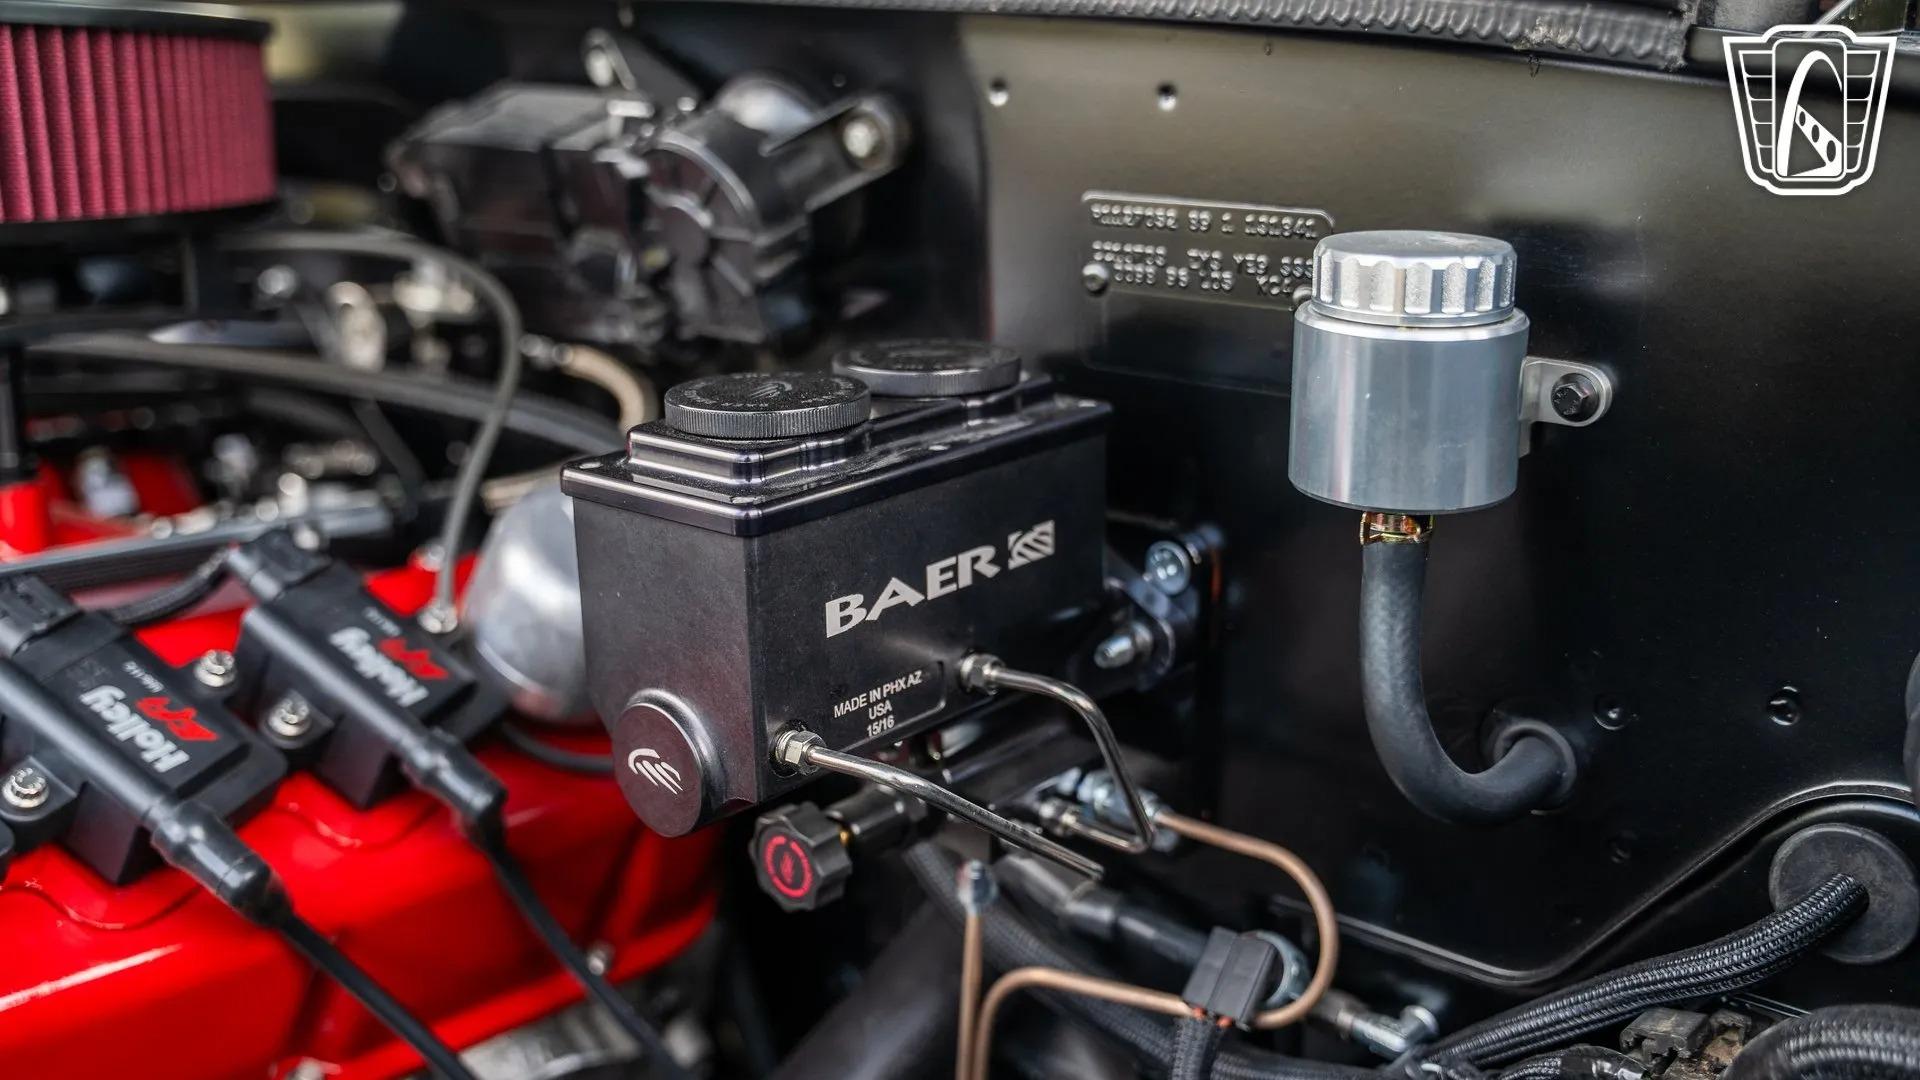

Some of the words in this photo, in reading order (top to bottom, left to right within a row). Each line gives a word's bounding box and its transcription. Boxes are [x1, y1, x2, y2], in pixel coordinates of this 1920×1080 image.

[825, 545, 1001, 639] BAER
[834, 692, 868, 719] MADE
[869, 686, 882, 704] IN
[882, 677, 907, 698] PHX
[906, 669, 923, 688] AZ
[868, 699, 893, 720] USA
[79, 684, 190, 773] Holley
[866, 714, 895, 737] 15/16
